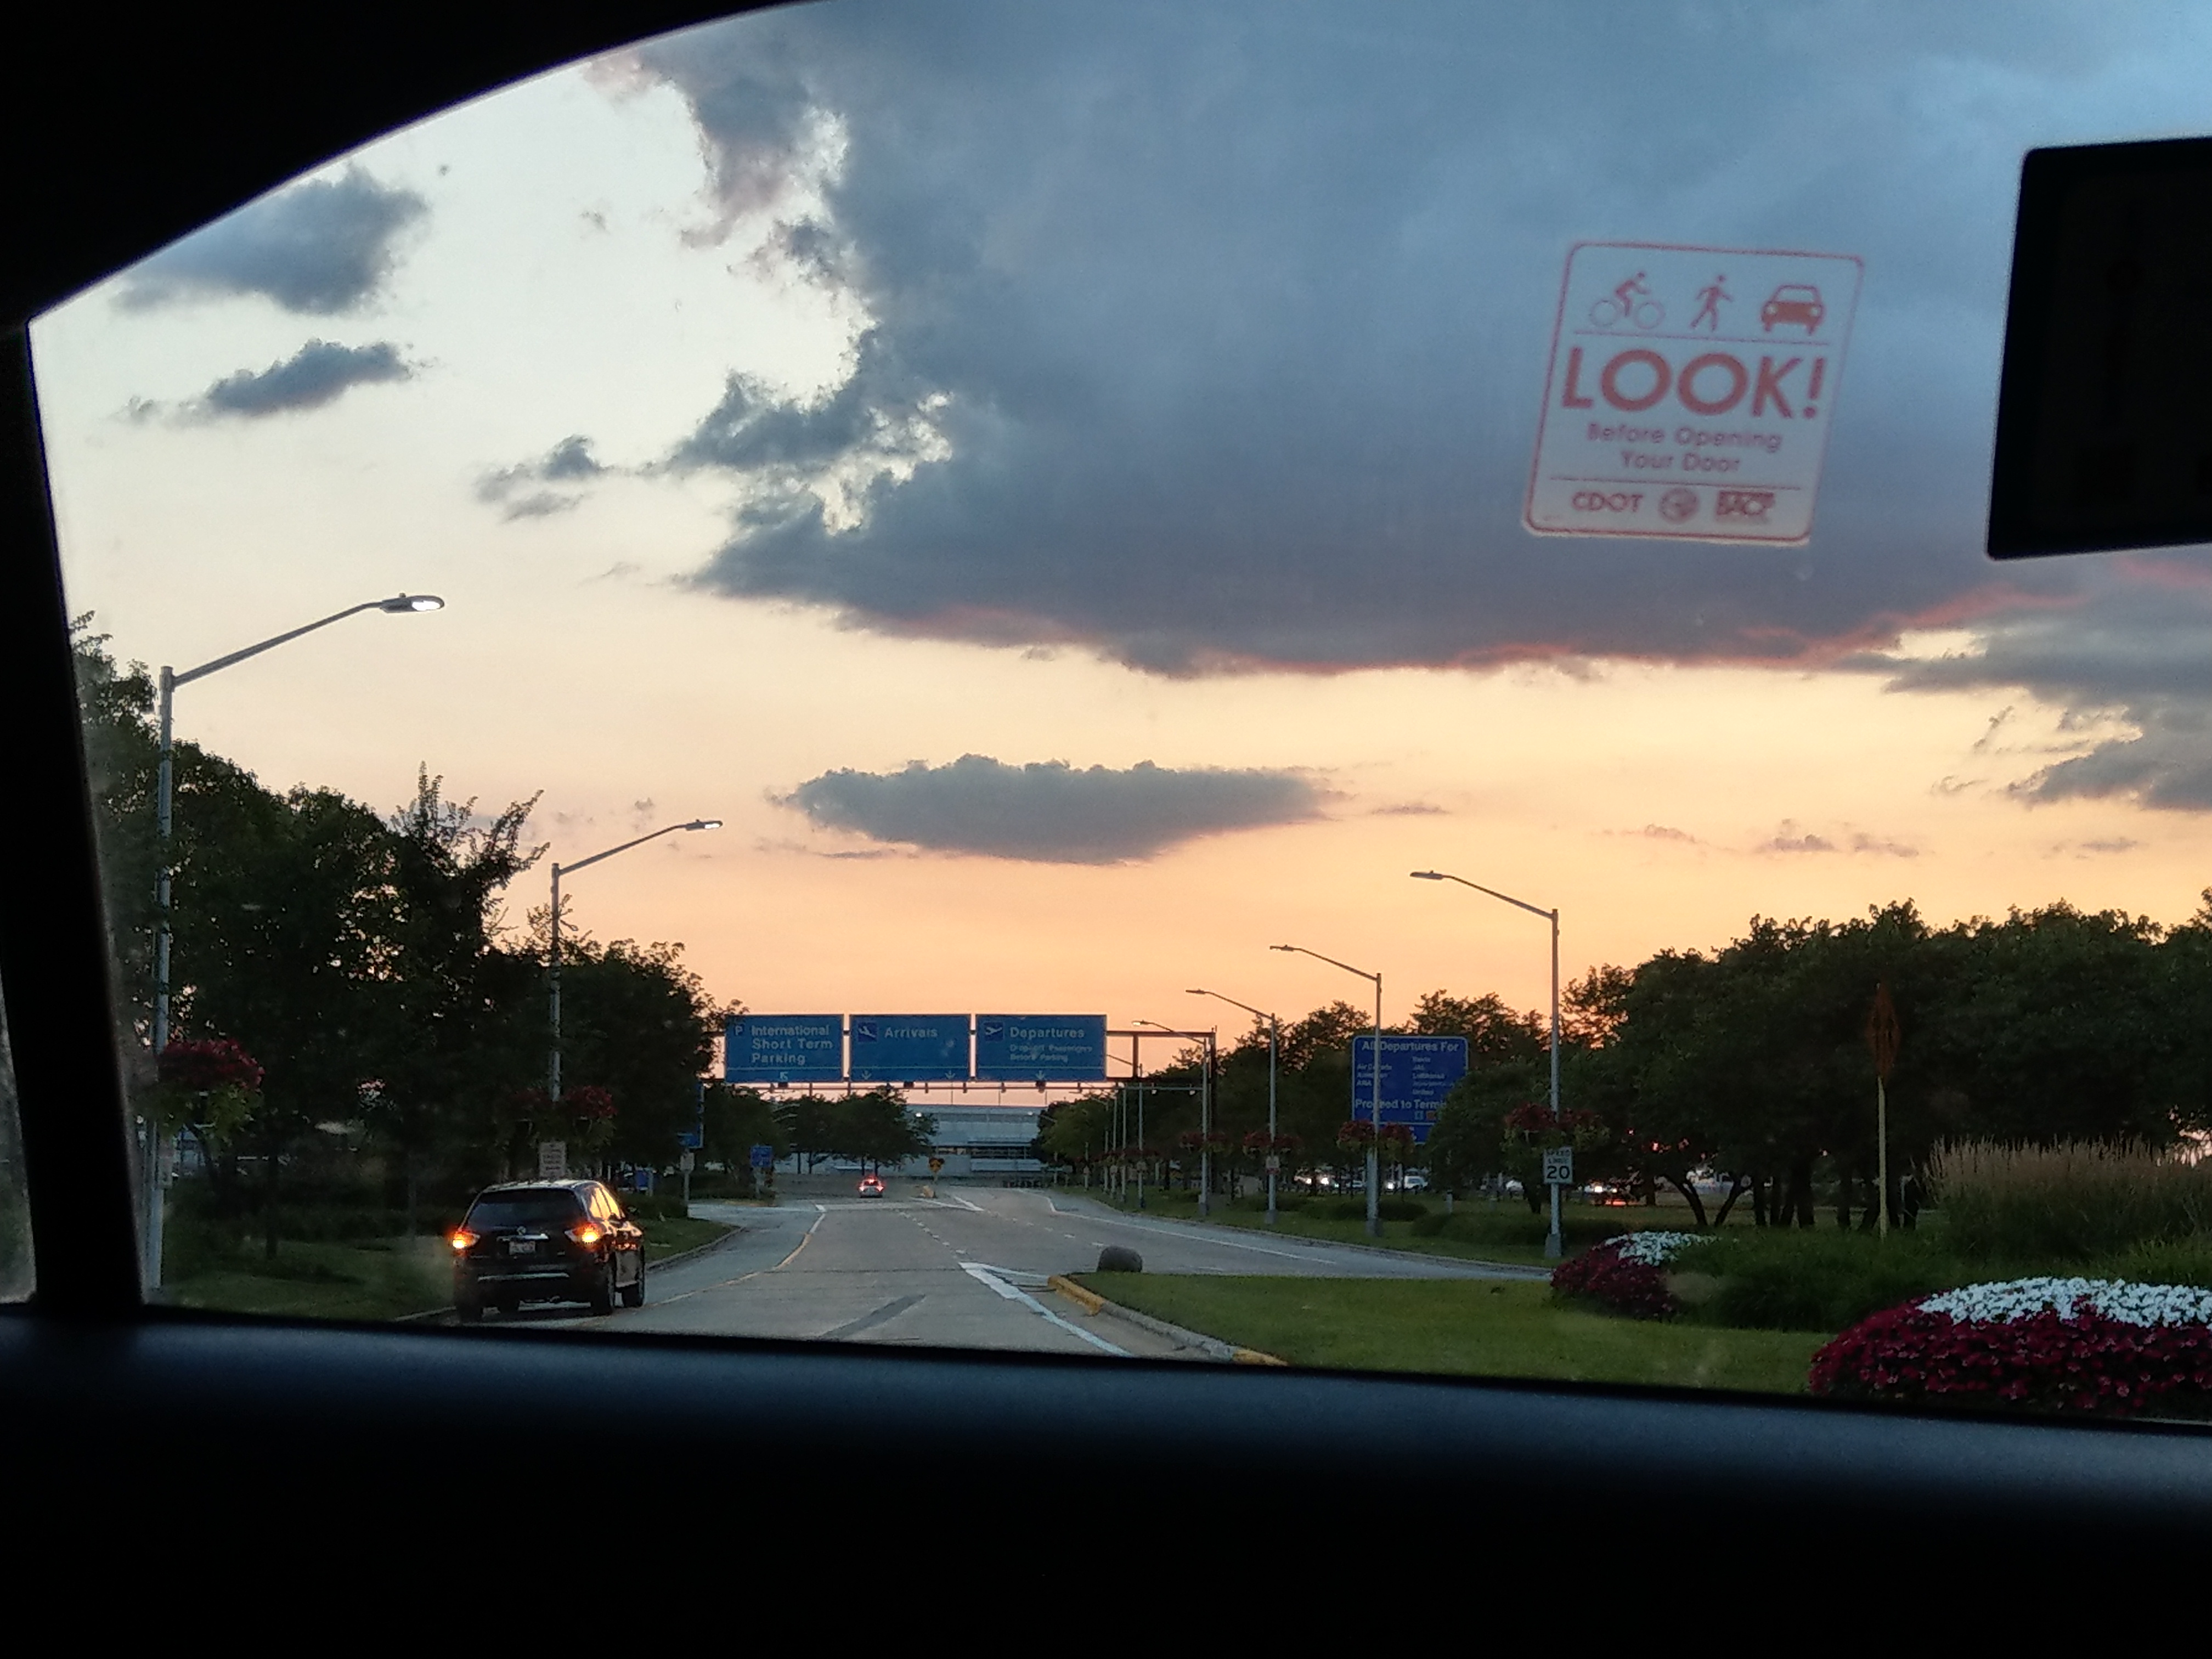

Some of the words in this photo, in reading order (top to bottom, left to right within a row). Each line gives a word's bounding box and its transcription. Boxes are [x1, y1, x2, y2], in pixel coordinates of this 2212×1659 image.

[1561, 347, 1826, 420] LOOK!
[1588, 422, 1666, 443] Before
[1675, 426, 1781, 454] Opening
[1621, 450, 1674, 468] Your
[1682, 452, 1740, 472] Door
[1572, 491, 1643, 512] CDOT
[752, 1025, 829, 1036] International
[884, 1027, 938, 1038] Arrivals
[1010, 1027, 1085, 1040] Departures
[752, 1038, 792, 1049] Short
[797, 1039, 833, 1049] Term
[1380, 1041, 1438, 1053] Departures
[1441, 1041, 1459, 1052] For
[752, 1053, 805, 1065] Parking
[1355, 1099, 1398, 1109] Proeed
[1401, 1099, 1412, 1109] to
[1547, 1165, 1570, 1180] 20
